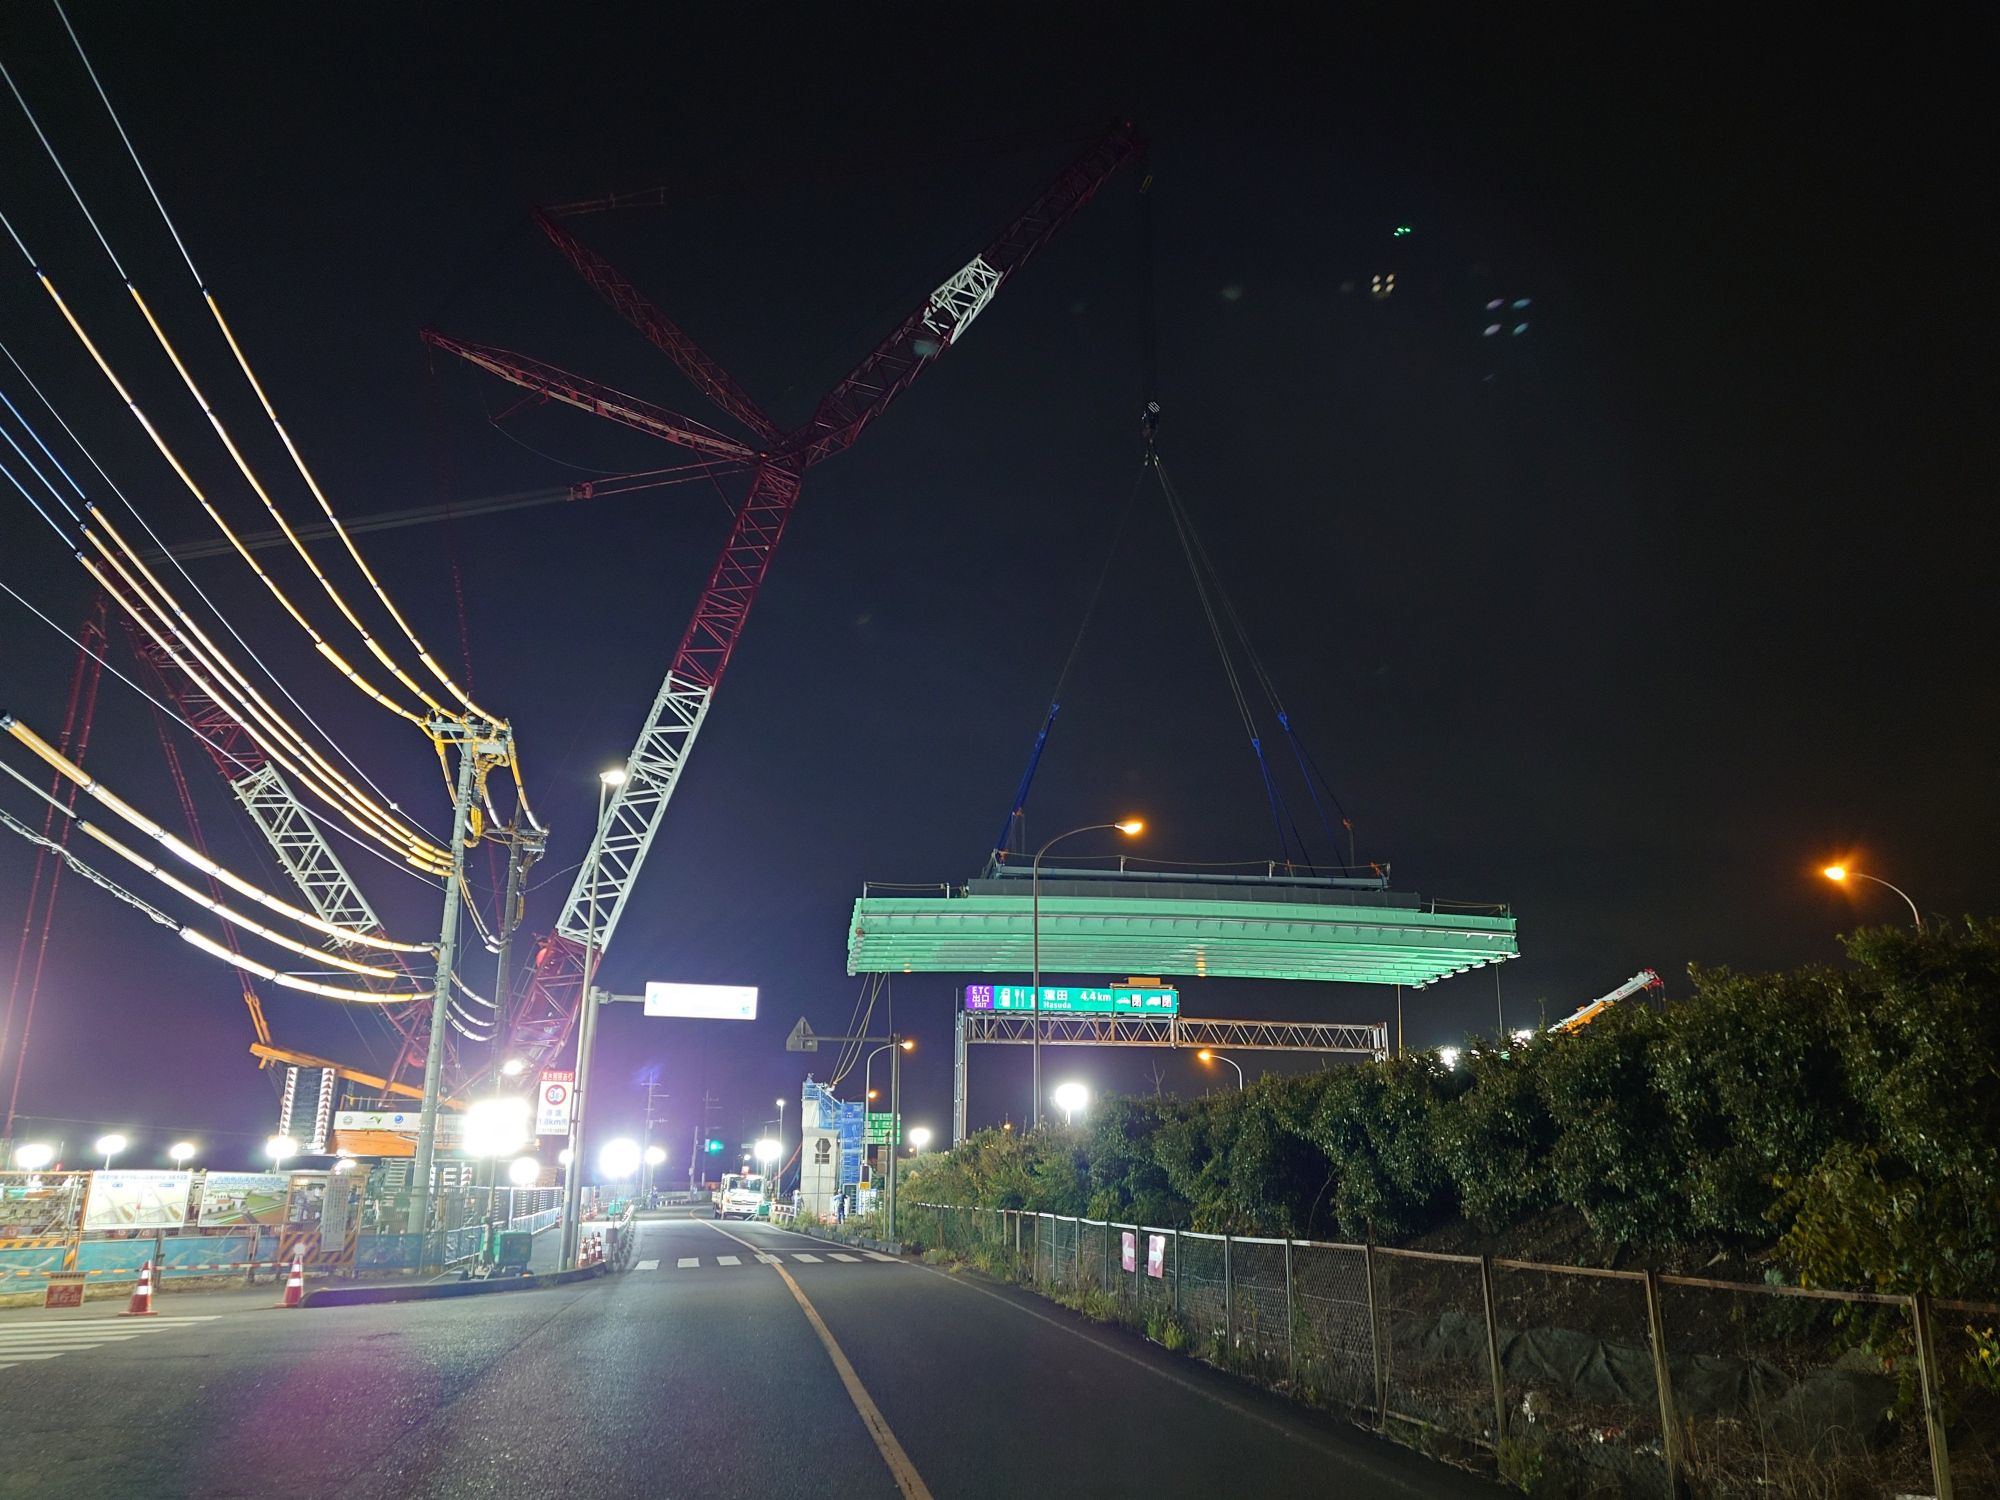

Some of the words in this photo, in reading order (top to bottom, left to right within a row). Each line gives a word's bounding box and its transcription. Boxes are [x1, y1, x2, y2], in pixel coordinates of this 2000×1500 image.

[972, 986, 990, 994] ETC
[972, 994, 990, 1003] 出口
[1080, 990, 1097, 1001] 4.4
[1097, 991, 1112, 1002] km
